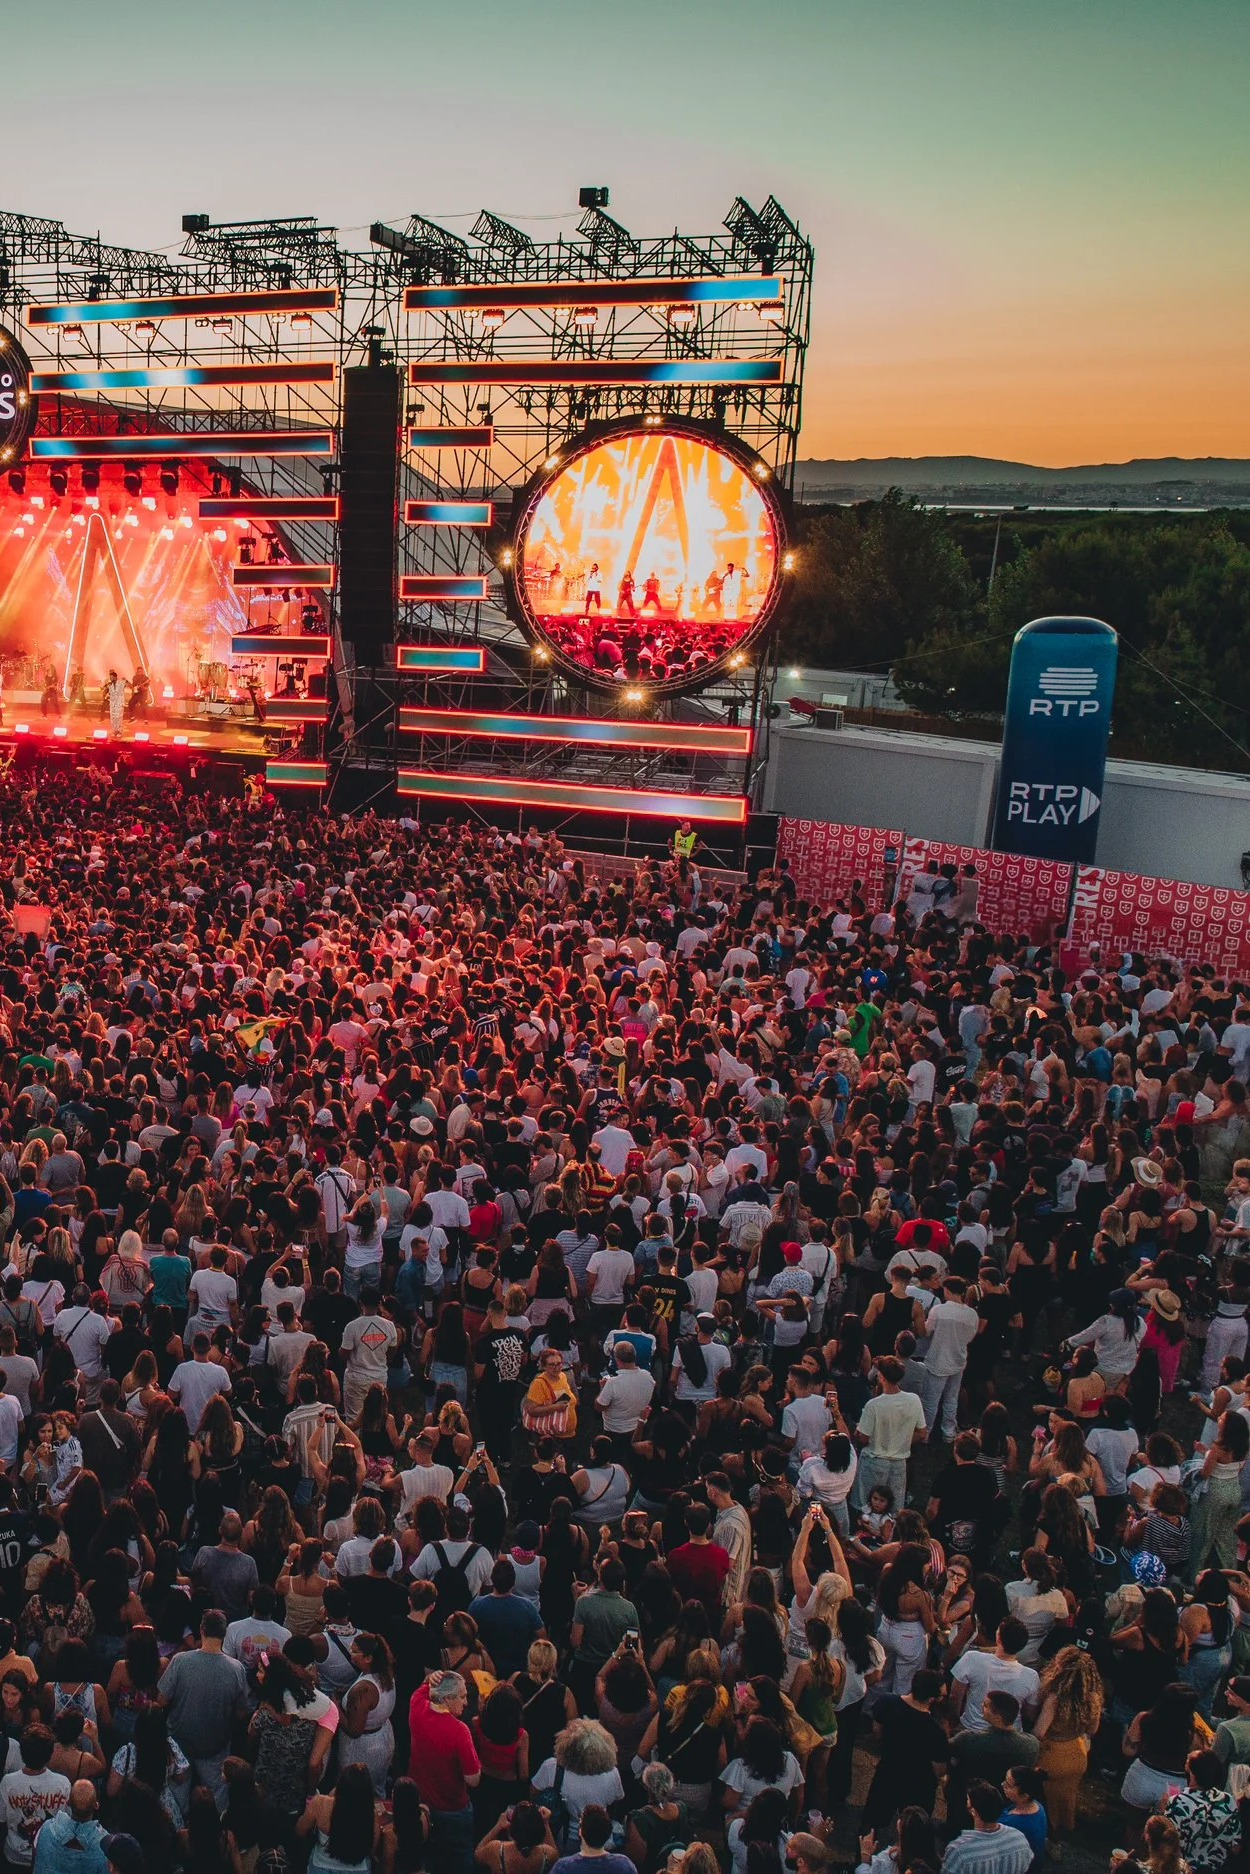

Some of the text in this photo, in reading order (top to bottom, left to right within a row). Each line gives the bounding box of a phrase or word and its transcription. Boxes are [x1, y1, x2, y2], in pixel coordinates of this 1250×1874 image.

[1029, 698, 1099, 717] RTP
[1010, 781, 1078, 801] RTP
[1007, 800, 1077, 825] PLAY
